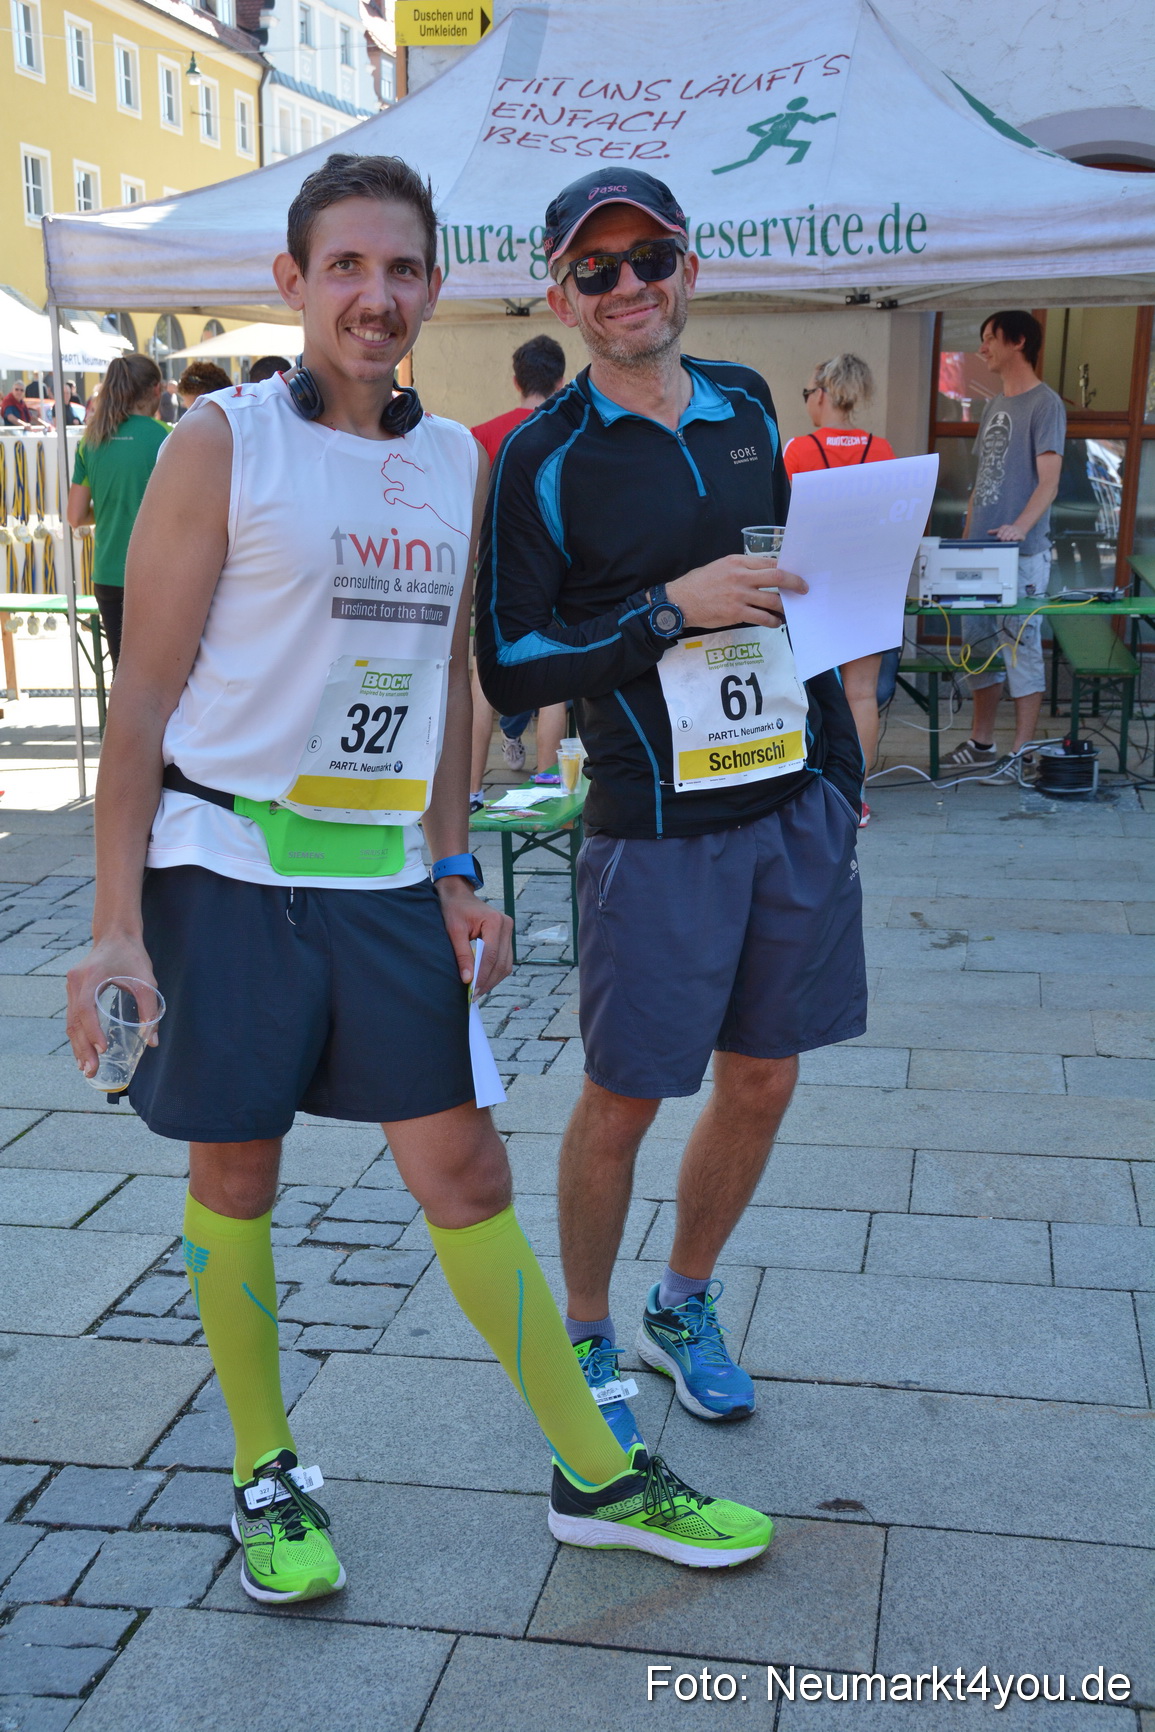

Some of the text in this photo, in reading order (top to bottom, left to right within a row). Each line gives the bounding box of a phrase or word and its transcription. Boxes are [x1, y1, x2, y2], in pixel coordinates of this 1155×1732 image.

[413, 8, 474, 21] Duschen und
[419, 24, 468, 37] Umkleiden
[578, 78, 673, 101] UNS
[730, 446, 757, 460] GORE
[330, 525, 456, 575] twinn
[333, 575, 455, 597] consulting & akademie
[341, 601, 443, 621] instinct for the future
[705, 642, 763, 665] BOCK
[361, 671, 413, 690] BOCK
[720, 672, 763, 720] 61
[340, 702, 409, 754] 327
[681, 720, 688, 728] B
[708, 722, 775, 742] PARTL Neumarkt
[310, 739, 318, 749] C
[709, 740, 786, 771] Schorschi
[329, 760, 392, 773] PARTL Neumarkt
[288, 851, 325, 860] SIEMENS
[260, 1487, 270, 1495] 327
